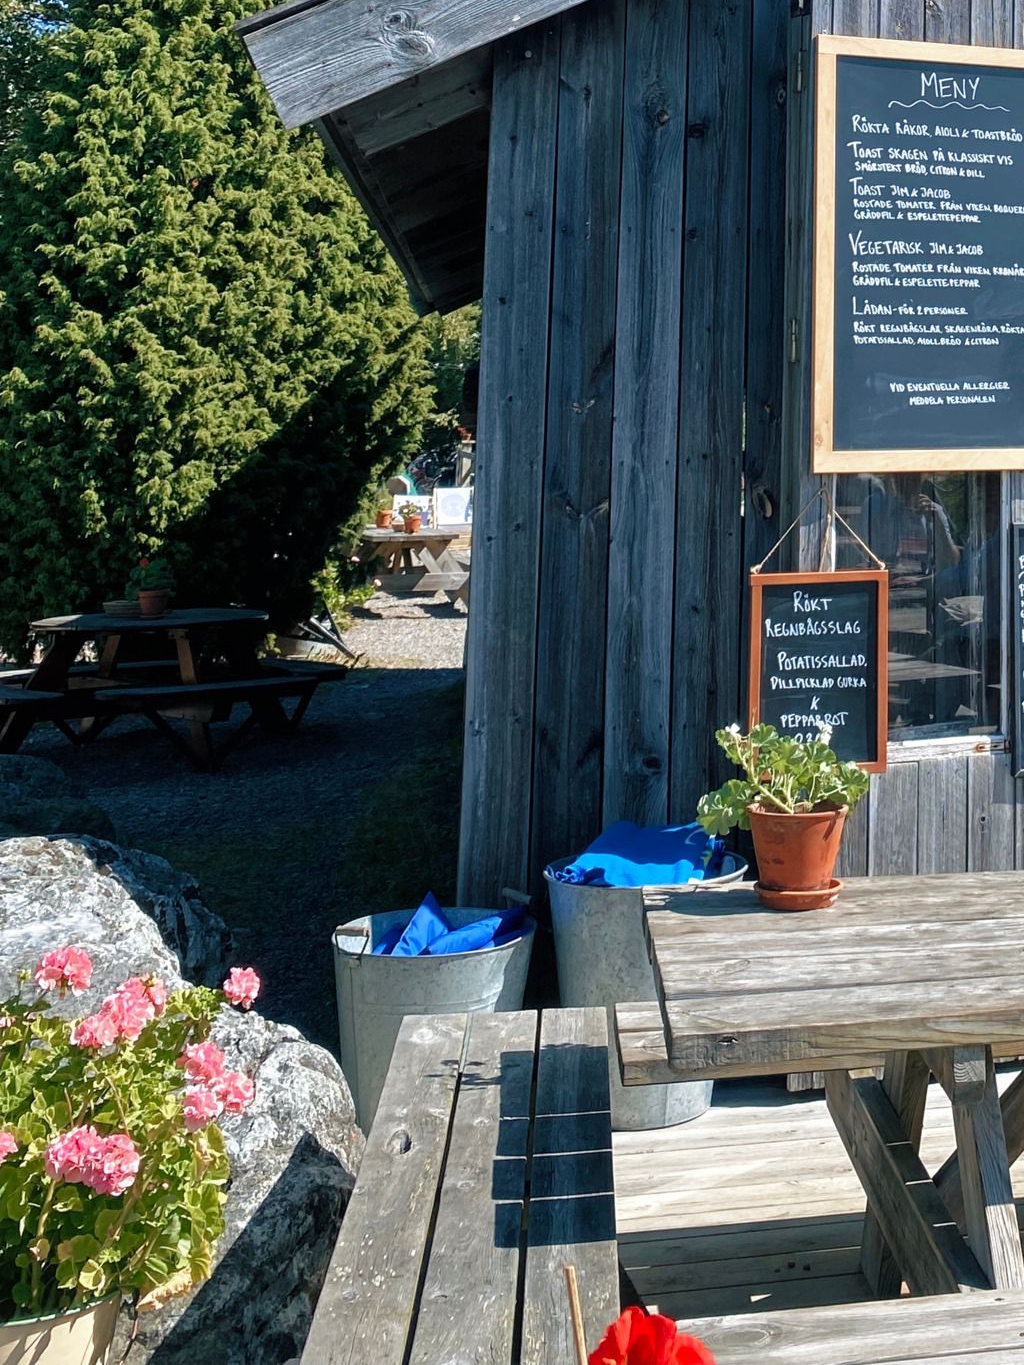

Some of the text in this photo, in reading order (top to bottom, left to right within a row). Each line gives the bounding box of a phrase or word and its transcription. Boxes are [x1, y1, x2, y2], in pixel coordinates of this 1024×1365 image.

[921, 72, 980, 100] MENY
[847, 141, 1013, 165] TOAST SKAGEN PÅ KLASSISKT VIS
[929, 165, 957, 176] CITRON
[966, 169, 985, 178] DILL
[849, 177, 886, 196] TOAST
[890, 184, 910, 197] JIM
[920, 187, 951, 199] JACOB
[853, 198, 893, 208] ROSTADE
[895, 200, 937, 210] TOMATER
[848, 229, 924, 255] VEGETARISK
[929, 241, 948, 254] JIM
[955, 243, 983, 255] JACOB
[852, 261, 892, 273] ROSTADE
[893, 262, 934, 273] TOMATER
[937, 262, 962, 273] FRÅN
[923, 306, 969, 315] PERSONER
[889, 381, 1010, 392] VID EVENTUELLA ALLERGIER
[909, 394, 996, 406] MEDDELA PERSONALEN
[793, 590, 833, 612] RÖKT
[770, 676, 867, 690] DILLPICKLAD GURKA
[780, 712, 849, 728] PEPPARROT
